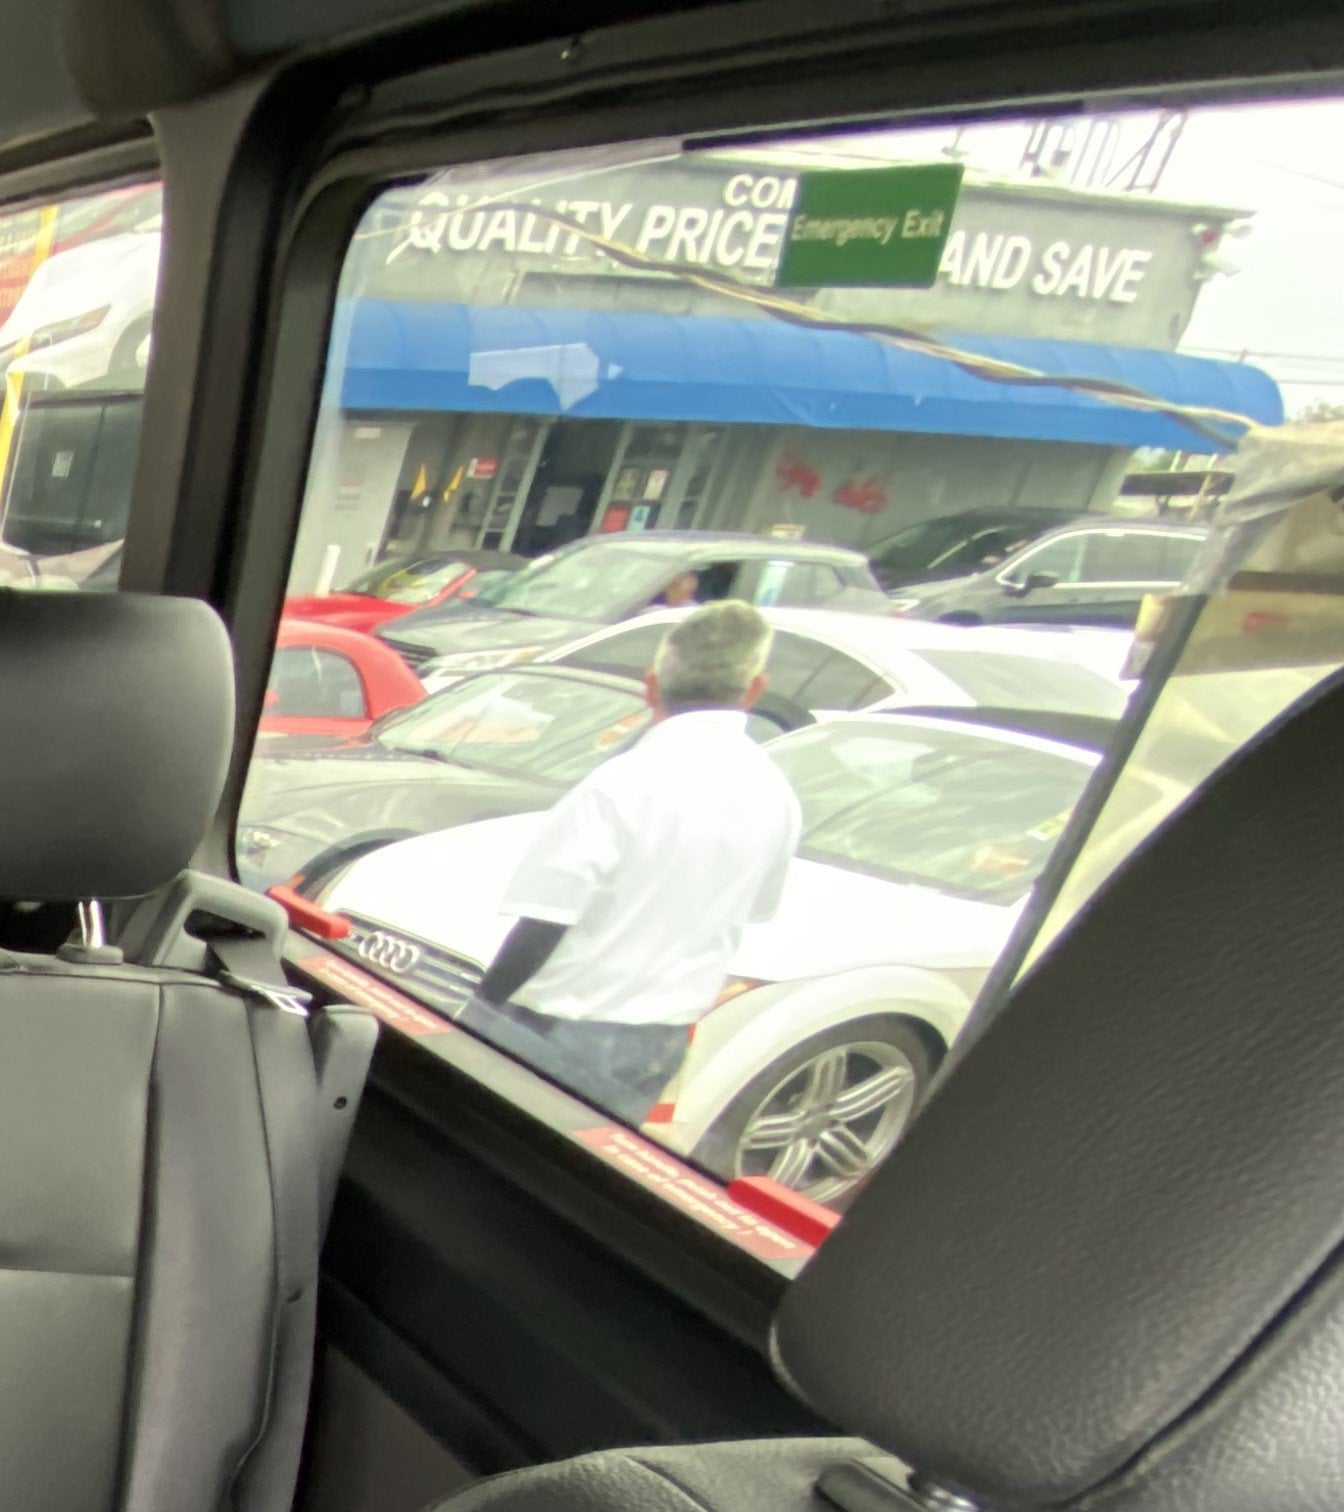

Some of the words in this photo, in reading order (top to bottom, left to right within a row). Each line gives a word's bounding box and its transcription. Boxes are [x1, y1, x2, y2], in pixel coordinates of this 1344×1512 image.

[411, 192, 634, 256] QUALITY
[636, 205, 788, 269] PRICE
[938, 230, 1031, 290] AND
[1033, 240, 1153, 302] SAVE
[791, 214, 899, 246] Emergency
[901, 209, 944, 238] Exit
